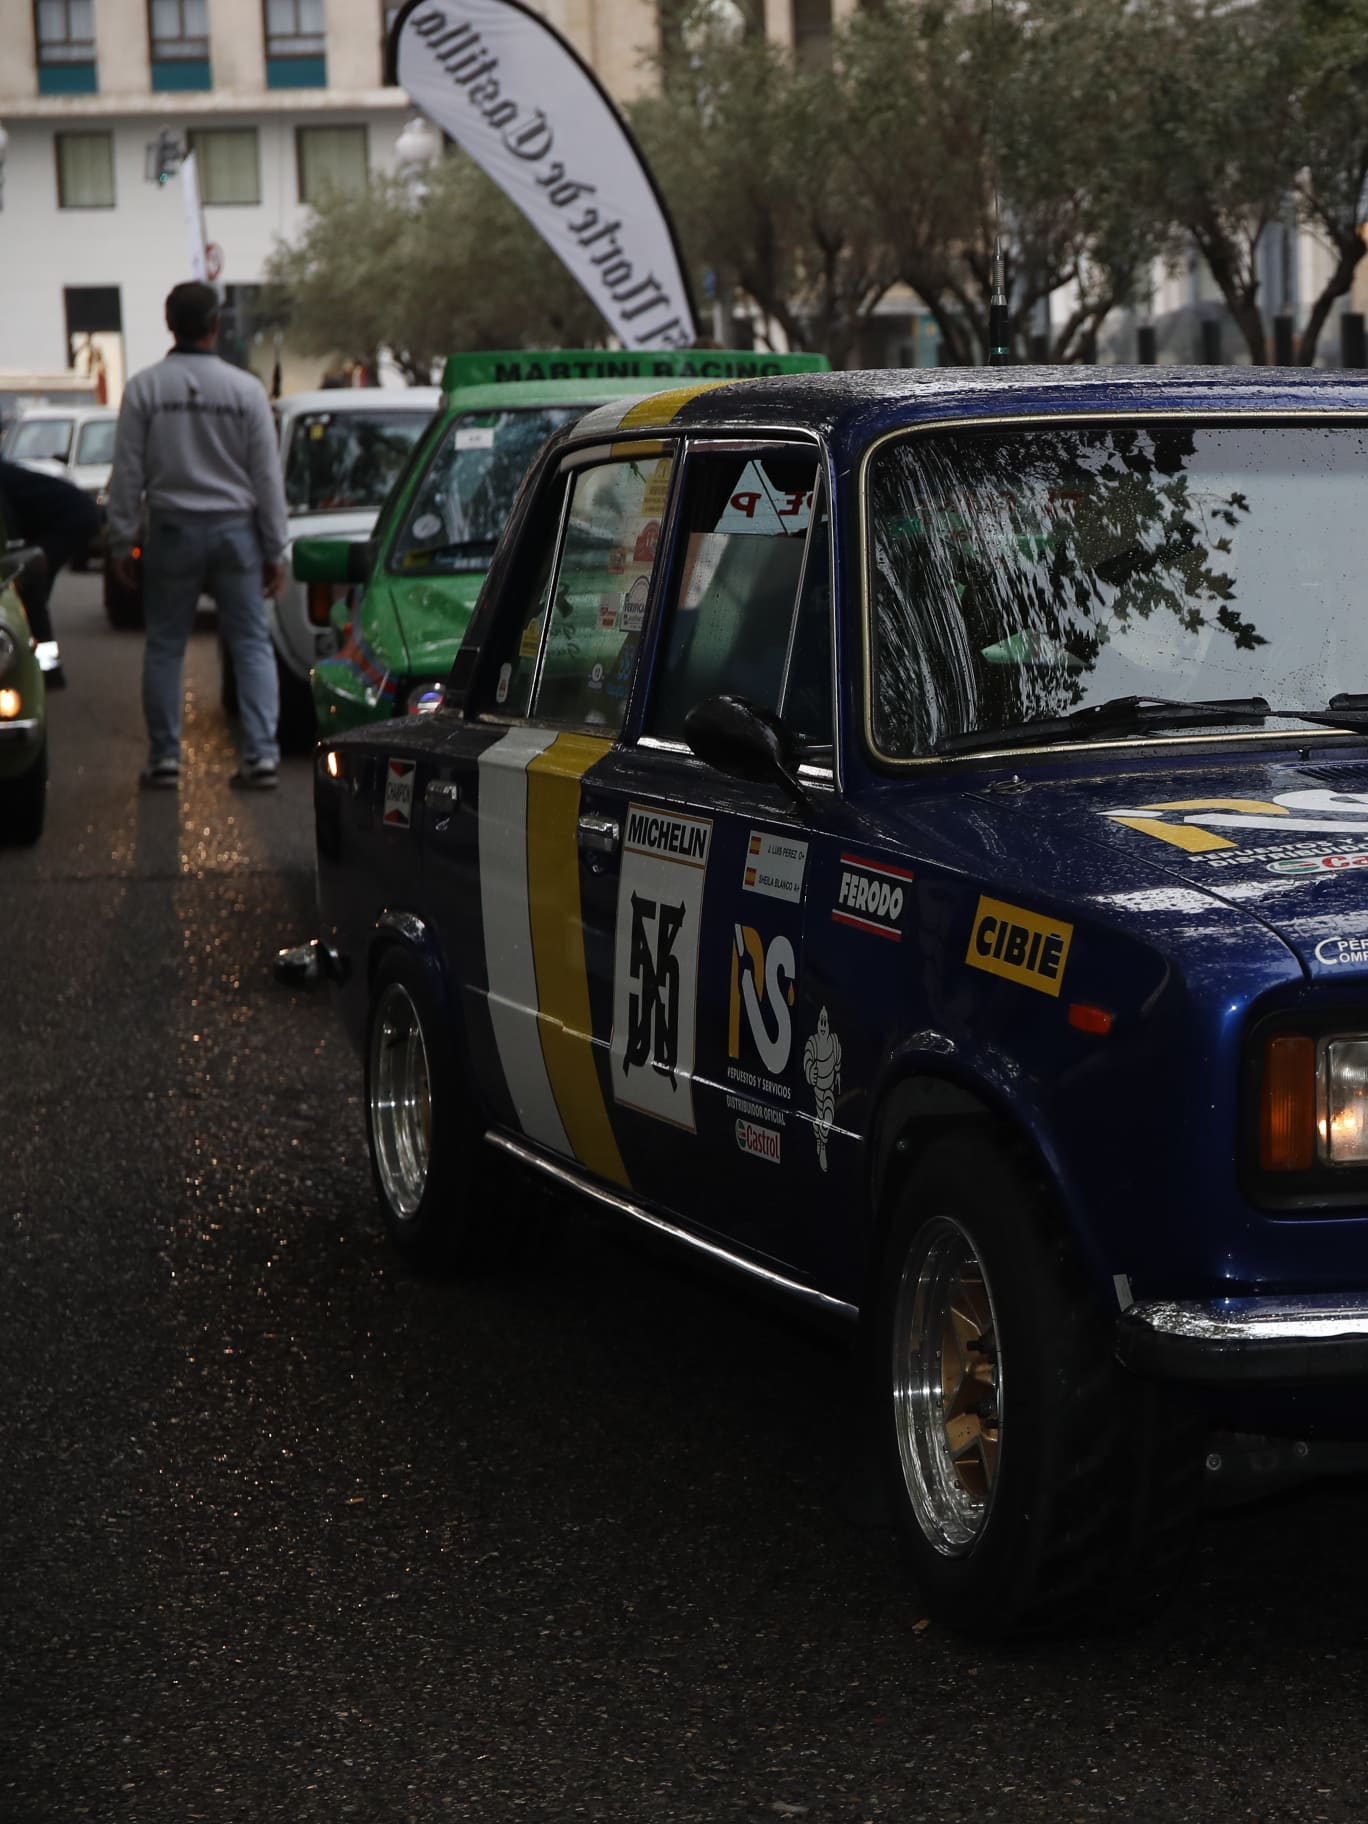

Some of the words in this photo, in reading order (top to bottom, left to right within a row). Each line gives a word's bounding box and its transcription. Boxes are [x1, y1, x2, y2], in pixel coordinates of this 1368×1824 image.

[495, 362, 640, 382] MARTINI
[654, 361, 783, 378] RACING
[628, 813, 707, 858] MICHELIN
[838, 871, 904, 920] FERODO
[976, 916, 1064, 979] CIBIÉ
[762, 1078, 791, 1099] SERVICIOS
[726, 1094, 764, 1119] DISTRIBUIDOR
[764, 1107, 786, 1127] OFICIAL
[746, 1124, 780, 1159] Castrol
